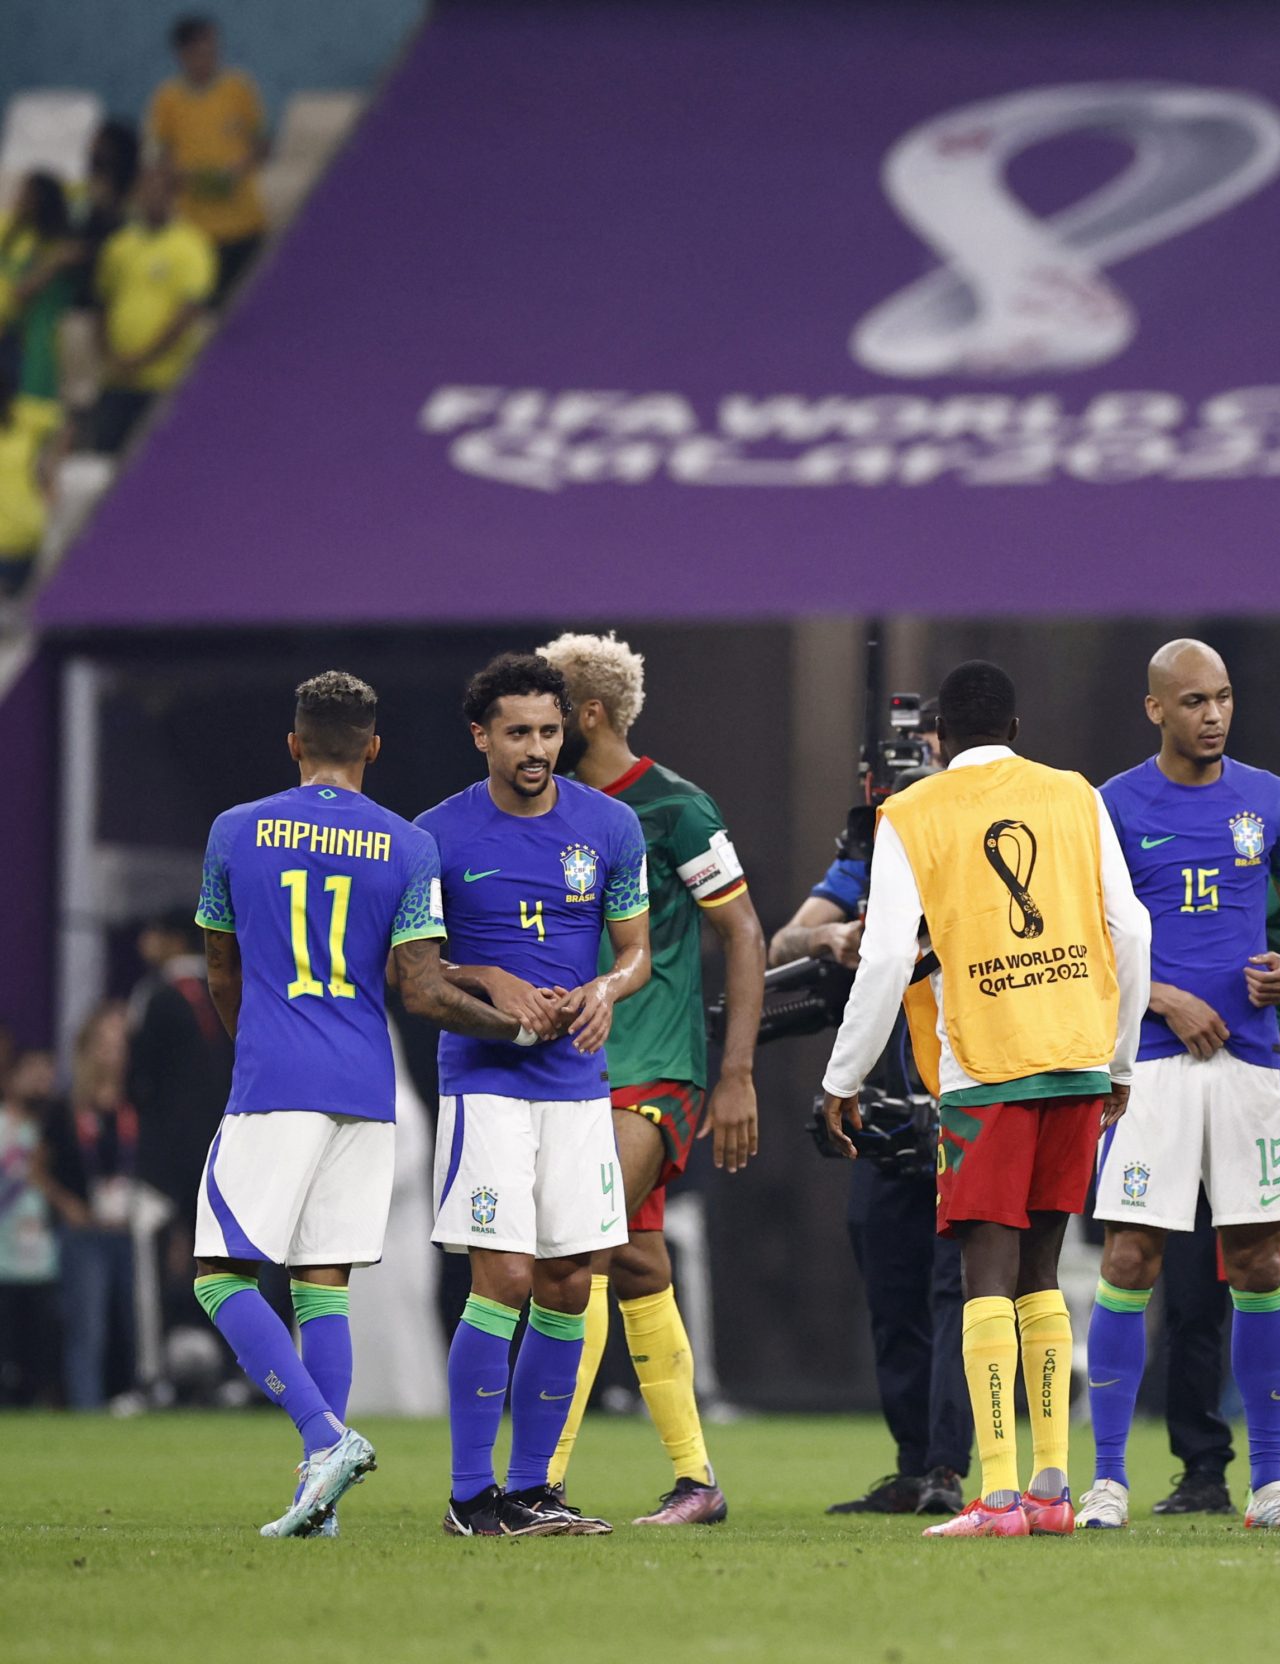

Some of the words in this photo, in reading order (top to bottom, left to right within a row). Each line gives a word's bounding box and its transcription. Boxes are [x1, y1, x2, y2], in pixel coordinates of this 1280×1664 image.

[421, 384, 696, 437] FIFA
[719, 389, 1184, 444] WORLD
[256, 819, 391, 862] RAPHINHA
[565, 893, 596, 903] BRASIL
[1180, 868, 1219, 912] 15
[280, 869, 356, 1000] 11
[520, 900, 545, 942] 4
[968, 957, 1005, 979] FIFA
[1006, 947, 1065, 969] WORLD
[1068, 945, 1087, 959] CUP
[601, 1162, 615, 1211] 4
[1121, 1199, 1147, 1208] BRASIL
[471, 1225, 496, 1234] BRASIL
[988, 1363, 1004, 1439] CAMEROUN
[1042, 1348, 1056, 1418] CAMEROUN
